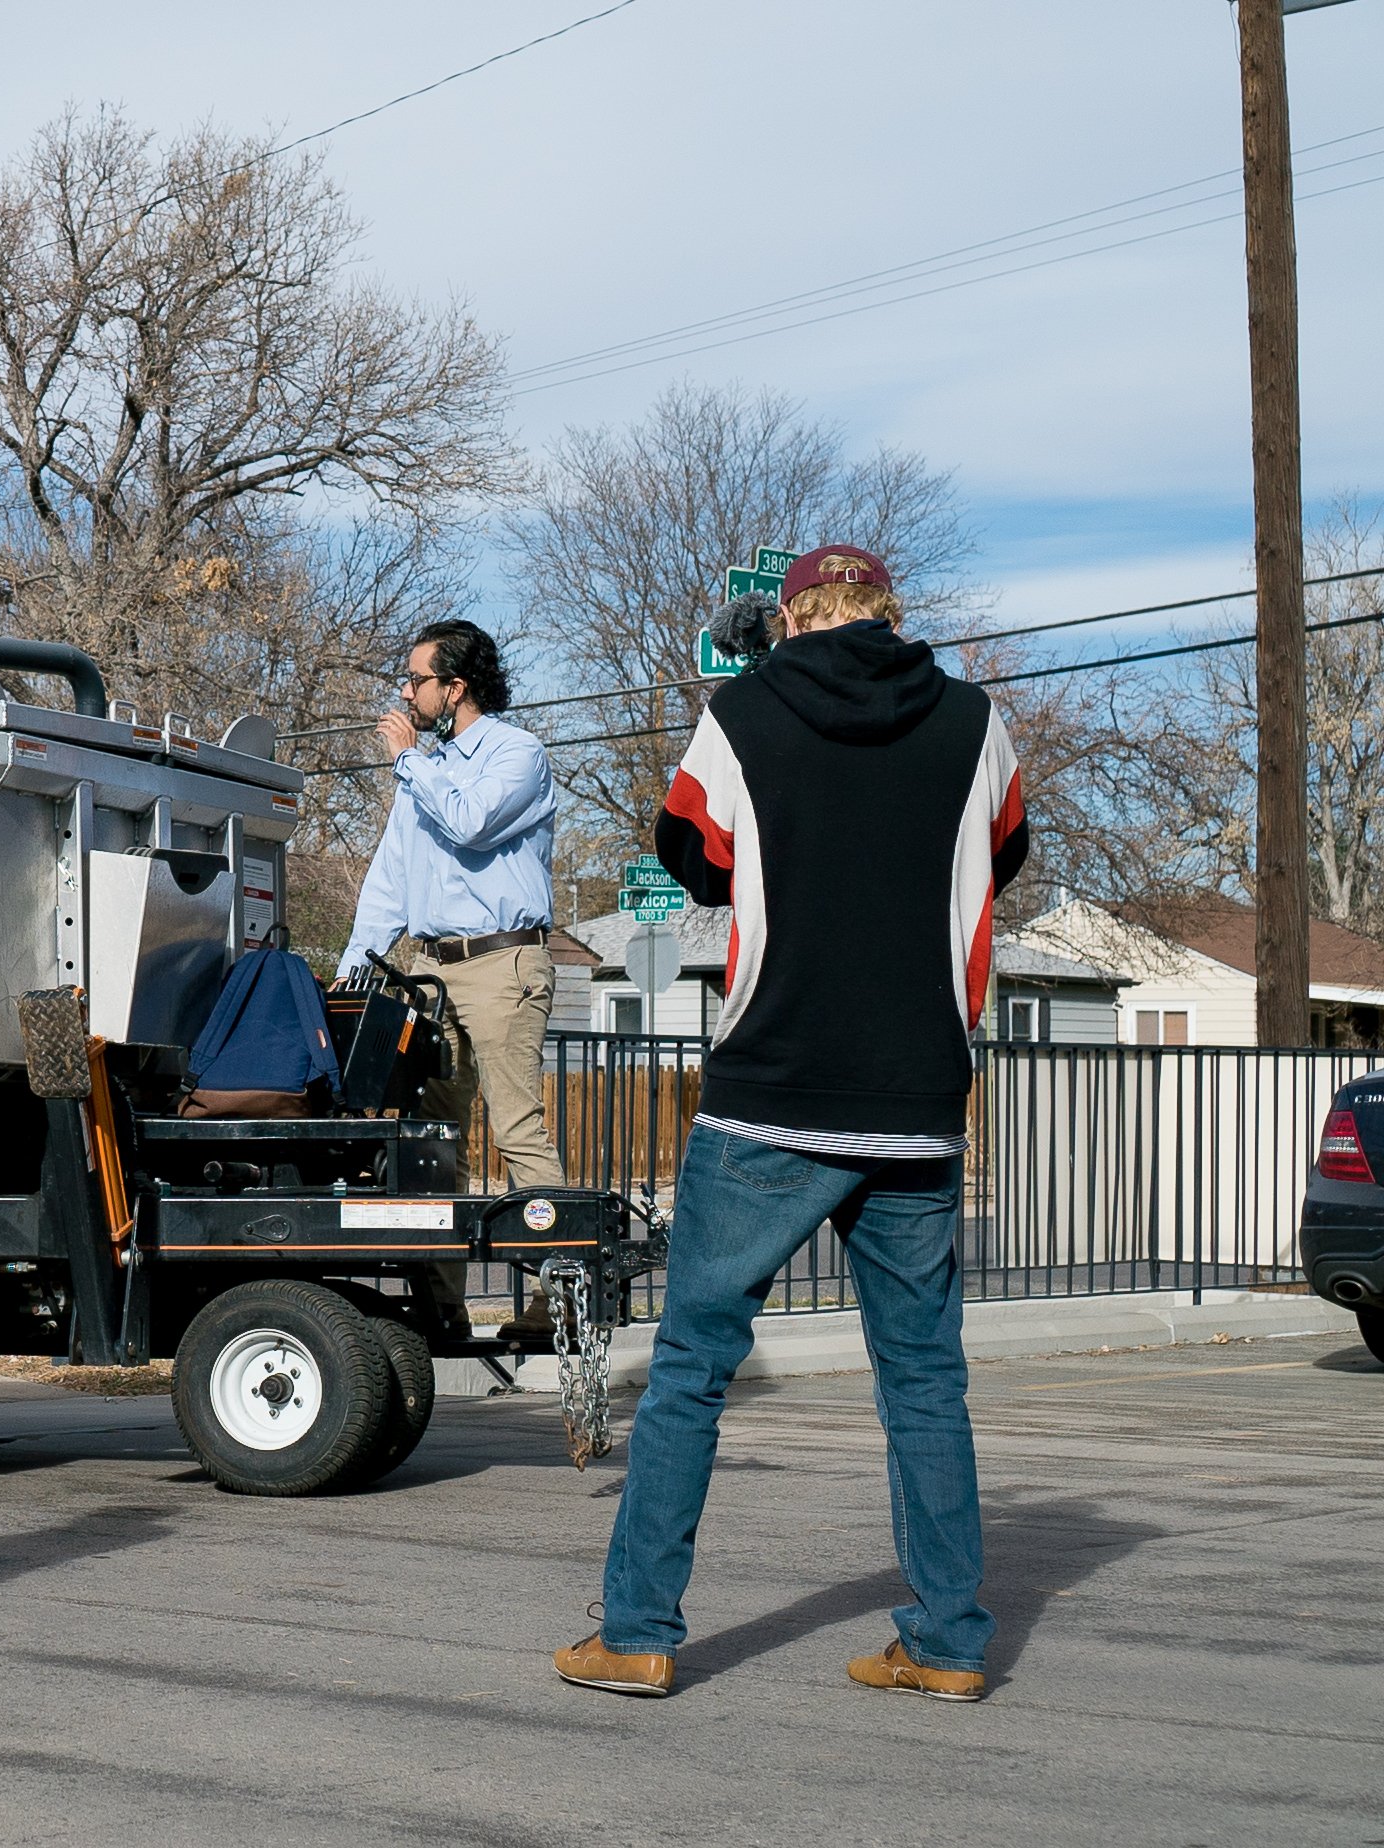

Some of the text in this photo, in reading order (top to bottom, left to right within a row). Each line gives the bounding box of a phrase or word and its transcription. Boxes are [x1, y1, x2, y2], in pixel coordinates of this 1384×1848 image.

[633, 869, 671, 885] Jackson
[624, 892, 668, 908] Mexico
[638, 911, 663, 920] 1700 S
